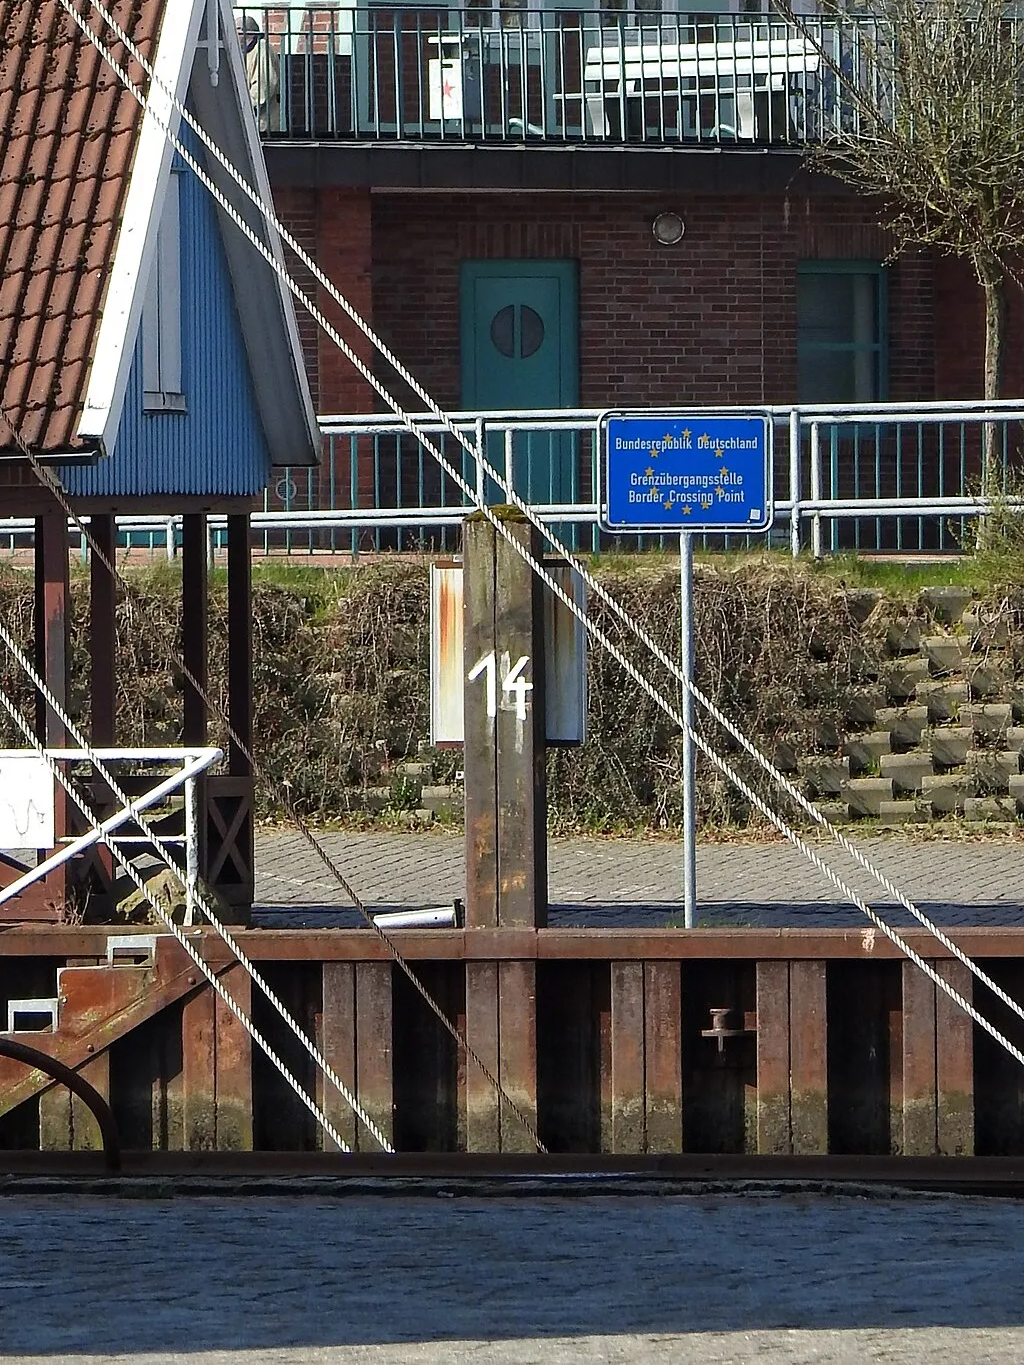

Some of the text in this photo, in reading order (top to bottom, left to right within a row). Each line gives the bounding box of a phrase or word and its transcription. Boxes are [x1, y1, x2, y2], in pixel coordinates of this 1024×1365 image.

[615, 436, 758, 452] Bundesrepublik Deutschland
[630, 472, 743, 488] Grenzübergangsstelle
[629, 489, 745, 506] Border Crossing Point
[467, 650, 534, 721] 14
